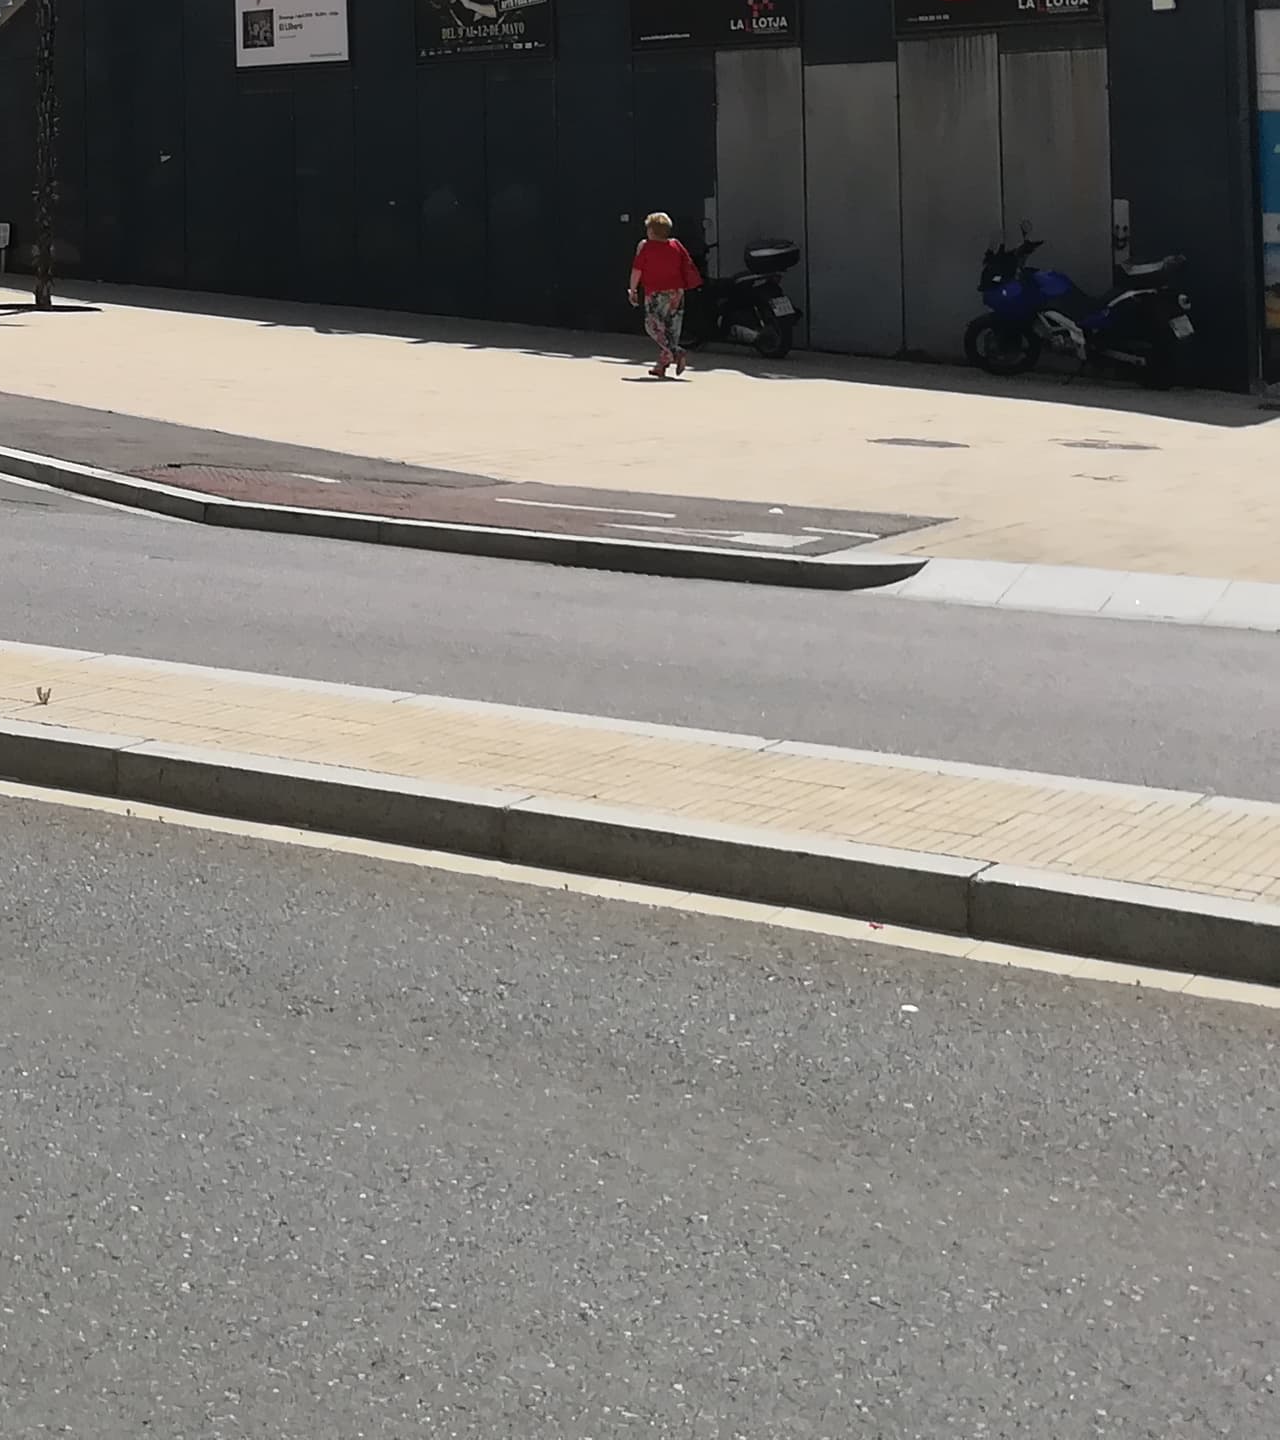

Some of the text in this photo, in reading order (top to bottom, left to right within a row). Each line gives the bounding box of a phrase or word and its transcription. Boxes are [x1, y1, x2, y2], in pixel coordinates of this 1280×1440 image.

[441, 27, 456, 39] DEL
[501, 22, 525, 35] MAYO
[730, 19, 744, 30] LA
